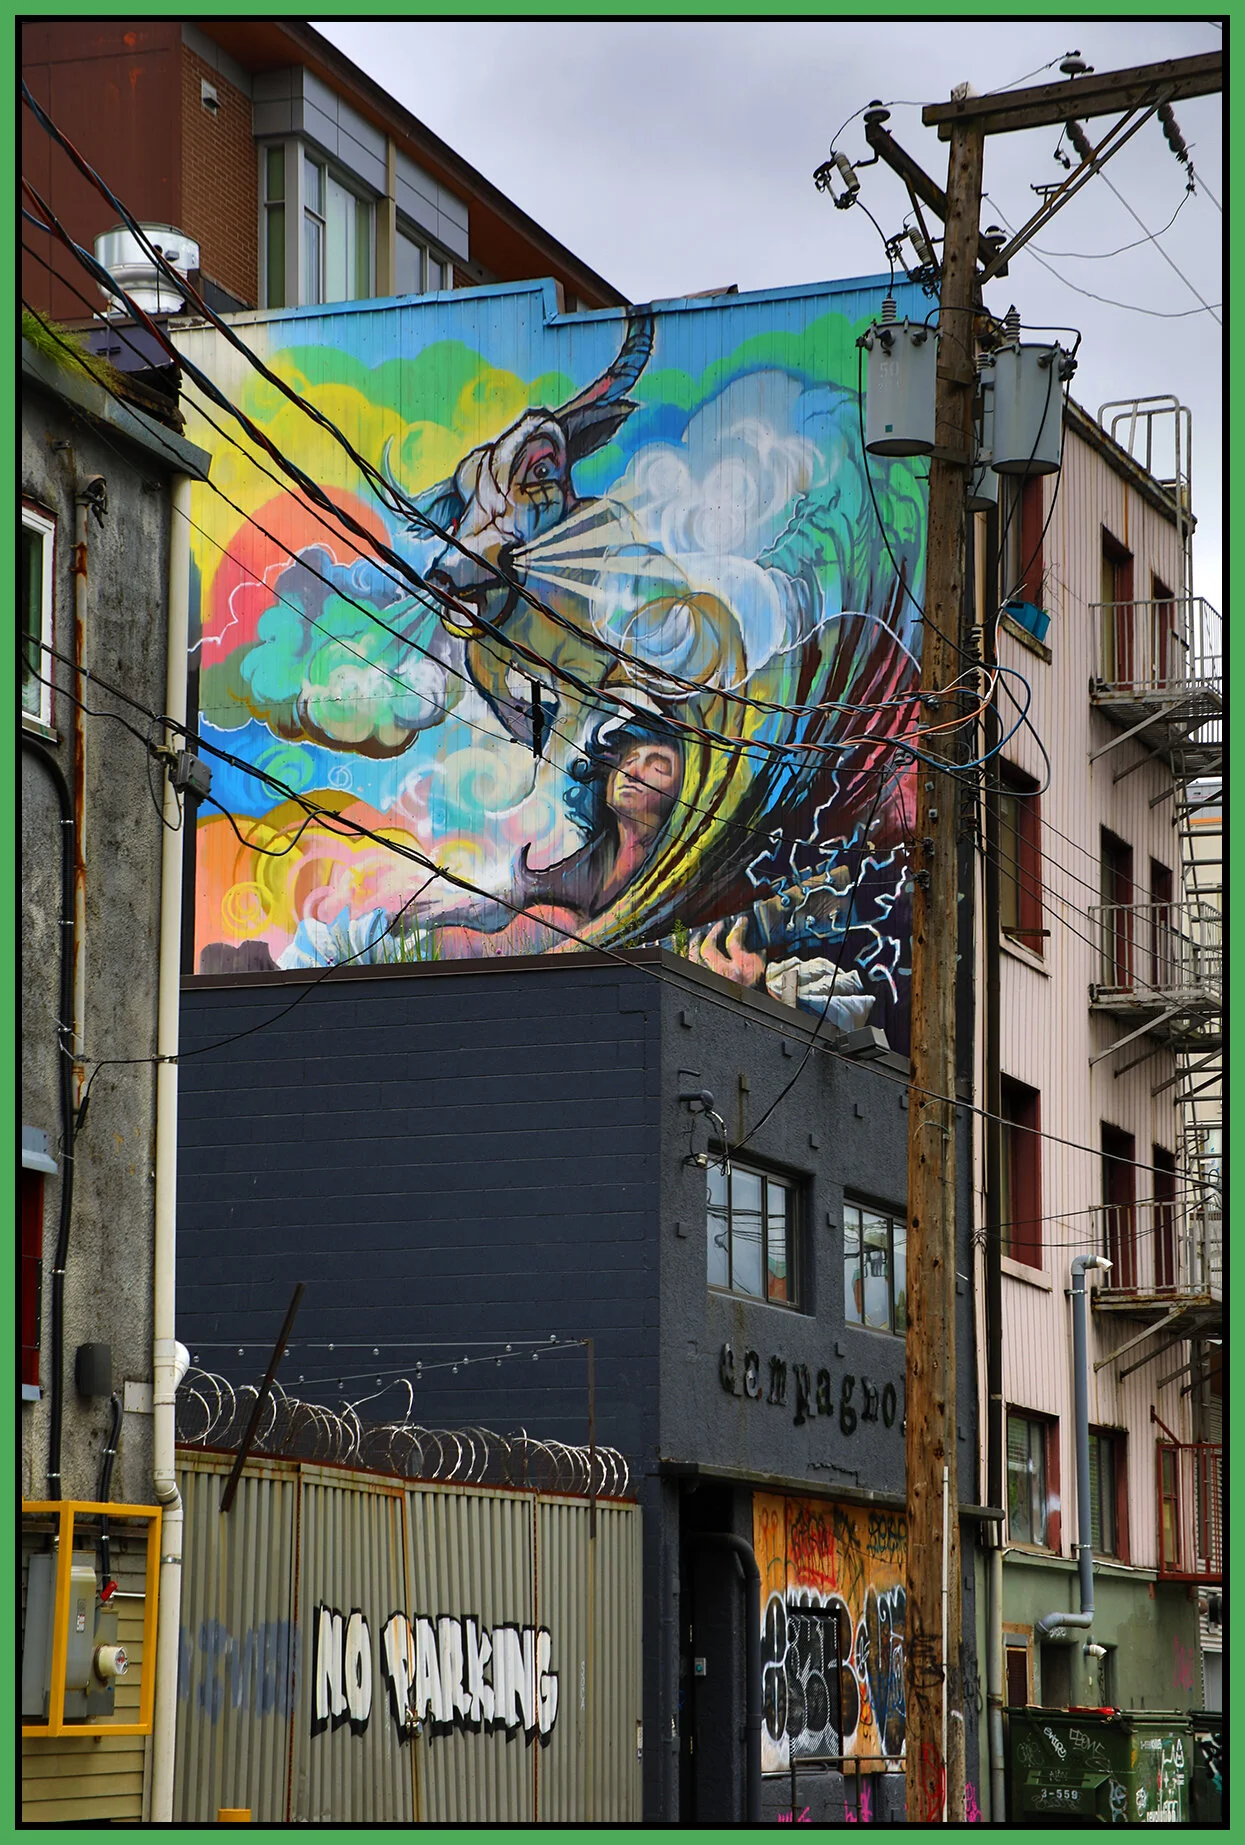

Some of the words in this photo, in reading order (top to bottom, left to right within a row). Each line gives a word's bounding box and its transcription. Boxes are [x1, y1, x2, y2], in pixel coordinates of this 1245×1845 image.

[719, 1342, 905, 1437] campagno
[311, 1599, 373, 1740] NO
[379, 1609, 560, 1749] PARKING
[1041, 1788, 1079, 1800] 3-559
